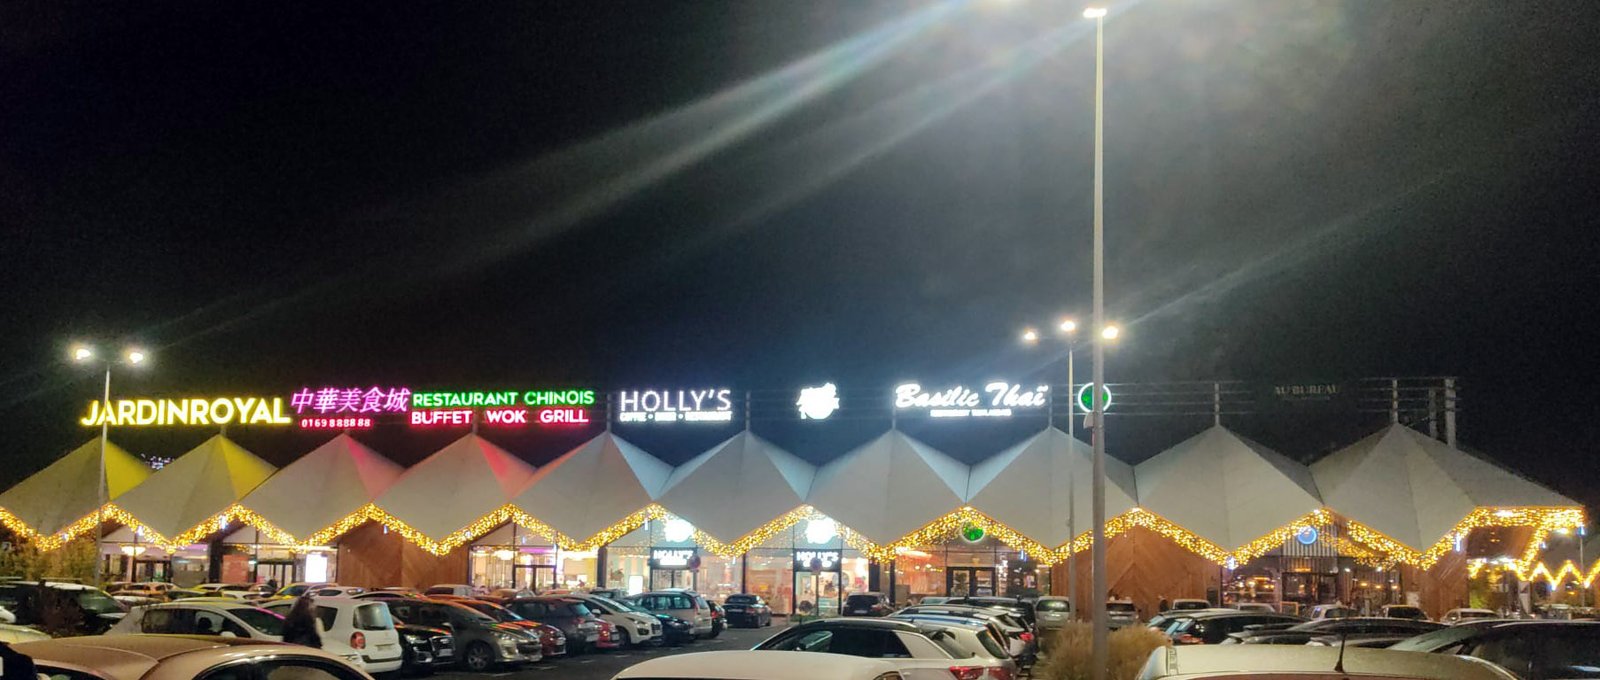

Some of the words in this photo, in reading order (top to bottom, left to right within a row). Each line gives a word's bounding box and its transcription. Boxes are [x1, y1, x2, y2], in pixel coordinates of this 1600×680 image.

[290, 386, 411, 414] 中華美食城
[412, 392, 519, 407] RESTAURANT
[524, 390, 595, 405] CHINOIS
[620, 389, 732, 412] HOLLY'S
[895, 383, 980, 408] Basilic
[984, 381, 1049, 407] Thaï
[411, 410, 473, 425] BUFFET
[486, 409, 527, 424] WOK
[540, 409, 589, 423] GRILL
